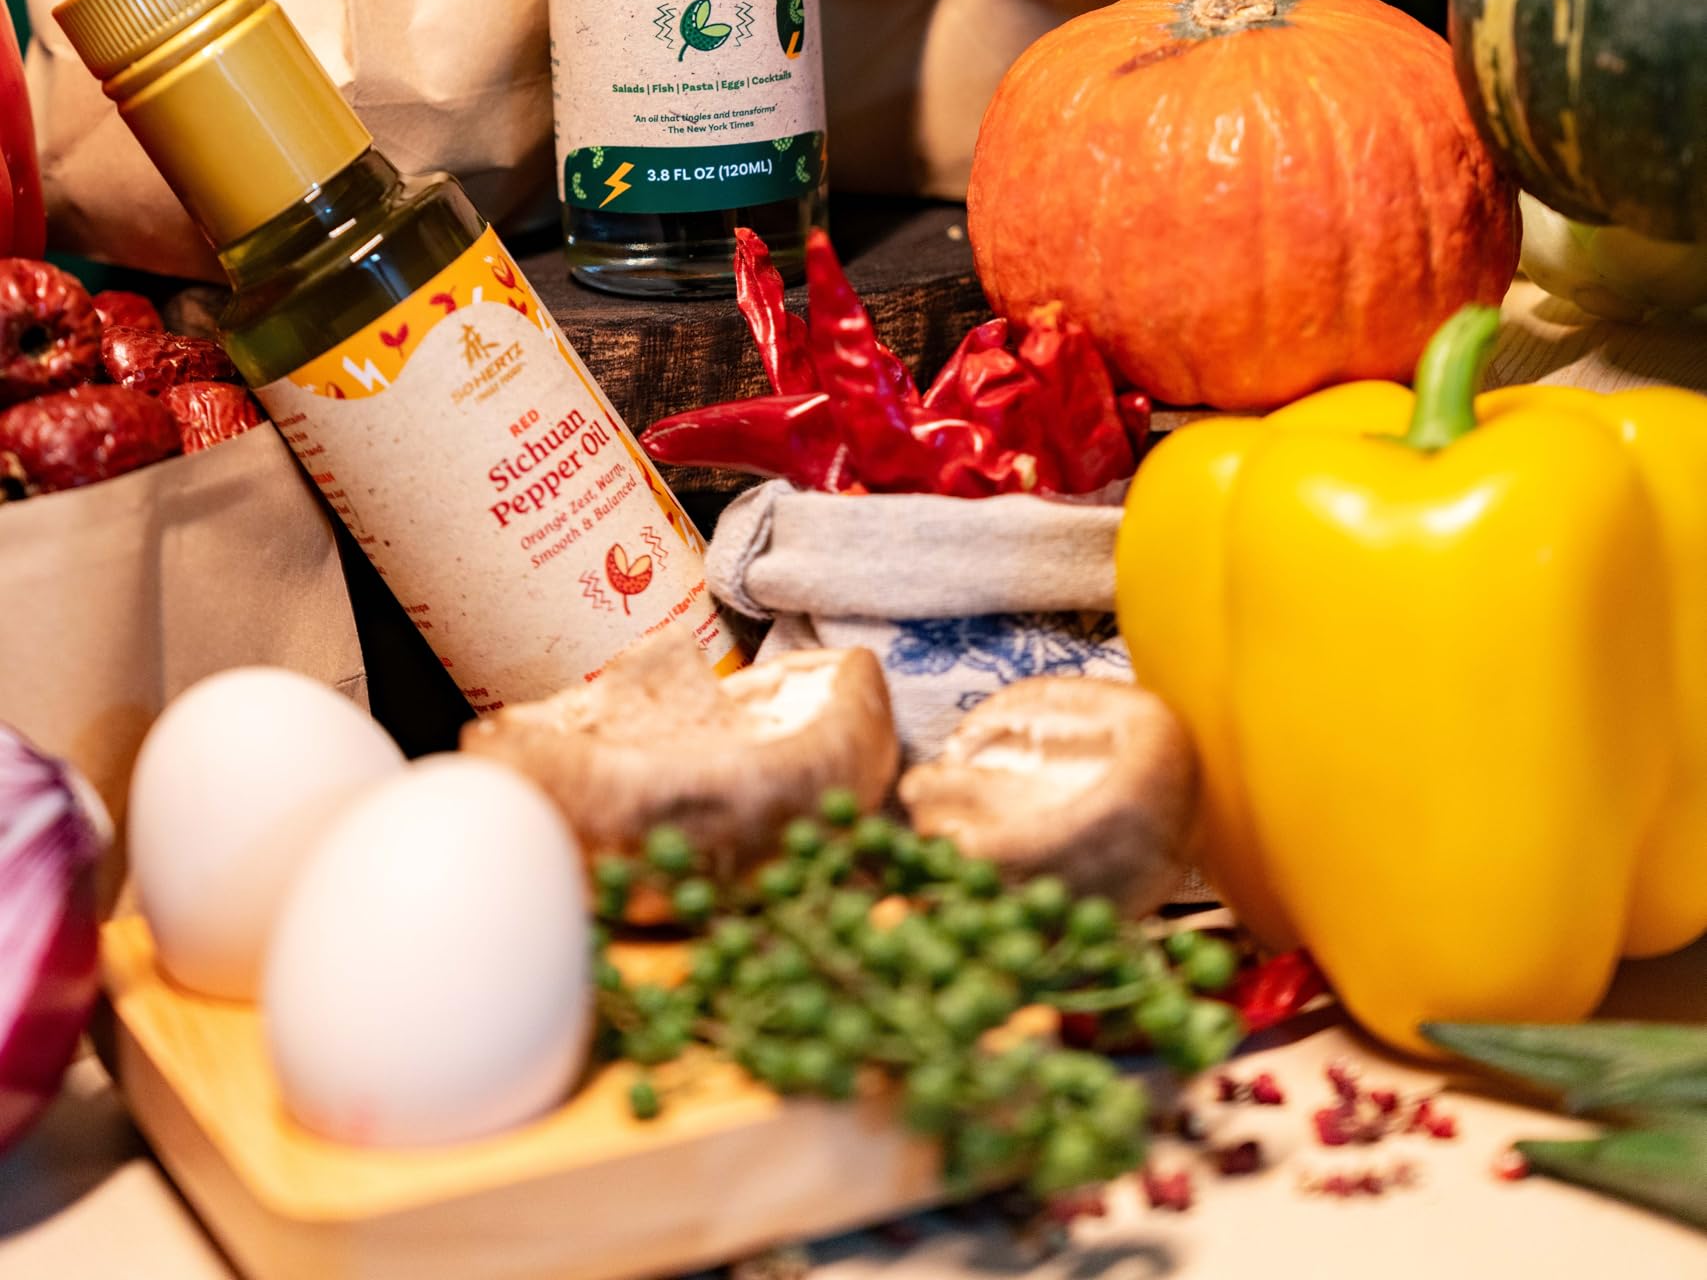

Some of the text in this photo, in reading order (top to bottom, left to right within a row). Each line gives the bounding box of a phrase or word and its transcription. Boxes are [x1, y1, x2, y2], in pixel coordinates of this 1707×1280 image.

[612, 84, 645, 93] Salads
[652, 84, 674, 93] Fish
[682, 83, 714, 92] Pasta
[721, 79, 745, 90] Eggs
[752, 70, 792, 85] Cocktails
[648, 115, 658, 123] oil
[660, 114, 679, 122] that
[681, 113, 711, 124] tingles
[714, 111, 730, 119] and
[668, 126, 685, 134] The
[687, 125, 706, 133] New
[707, 123, 728, 132] York
[730, 121, 754, 130] Times
[647, 158, 772, 181] 3.8 FL OZ (120ML)
[509, 409, 540, 438] RED
[488, 408, 586, 492] Sichuan
[488, 420, 610, 528] Pepper Oil
[520, 462, 626, 550] Orange Zest, Warm,
[530, 527, 581, 569] Smooth
[593, 474, 637, 521] Balanced
